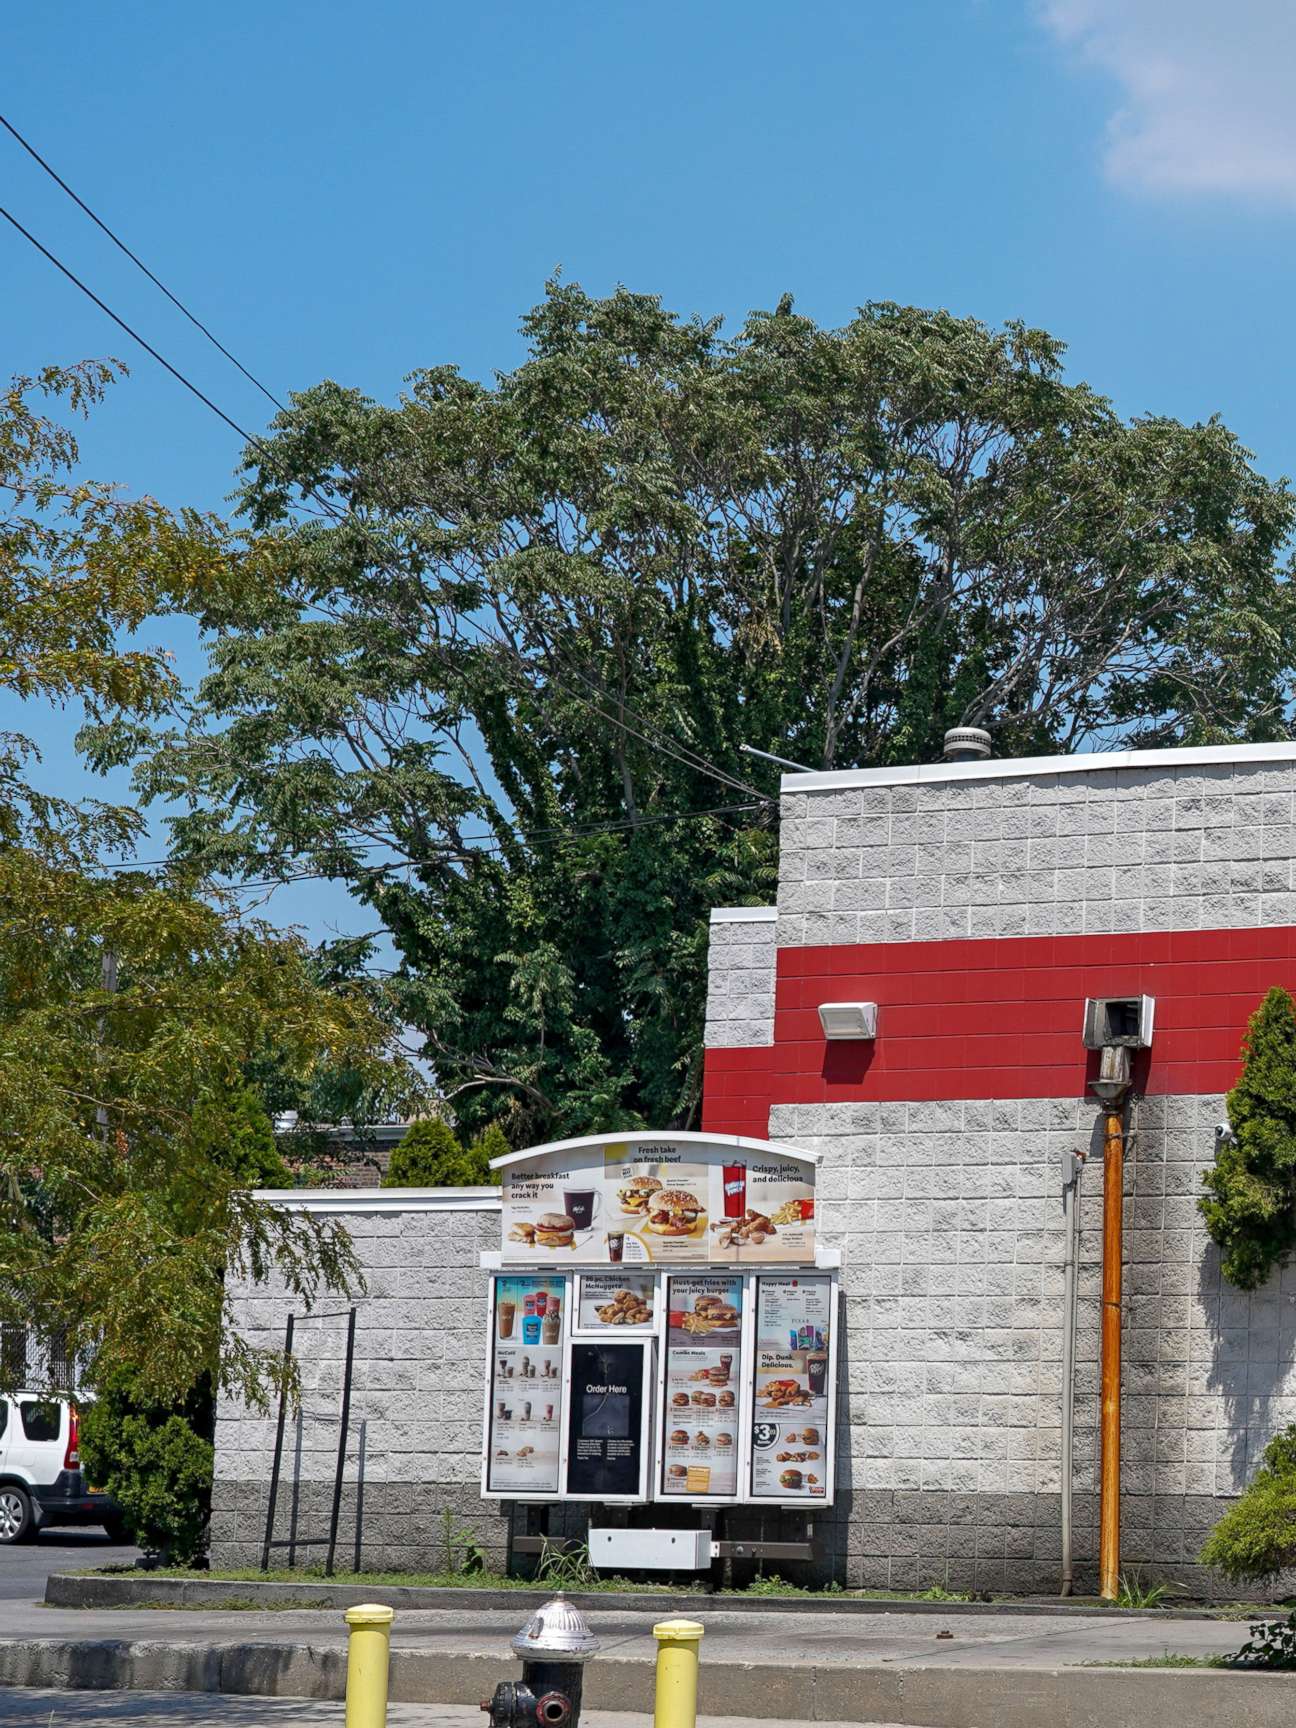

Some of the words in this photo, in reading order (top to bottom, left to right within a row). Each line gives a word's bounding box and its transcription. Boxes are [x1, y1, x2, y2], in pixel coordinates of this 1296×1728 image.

[638, 1145, 659, 1154] Fresh
[660, 1145, 677, 1154] take
[644, 1155, 664, 1163] fresh
[665, 1155, 682, 1163] beef
[511, 1172, 534, 1180] Better
[535, 1172, 570, 1180] breakfast
[752, 1175, 767, 1183] and
[768, 1175, 804, 1183] delicious
[511, 1183, 525, 1191] any
[525, 1183, 540, 1191] way
[541, 1183, 554, 1191] you
[511, 1191, 531, 1199] crack
[532, 1191, 538, 1199] it
[688, 1287, 705, 1295] juicy
[706, 1287, 729, 1295] burger
[586, 1384, 608, 1394] Order
[608, 1384, 628, 1394] Here
